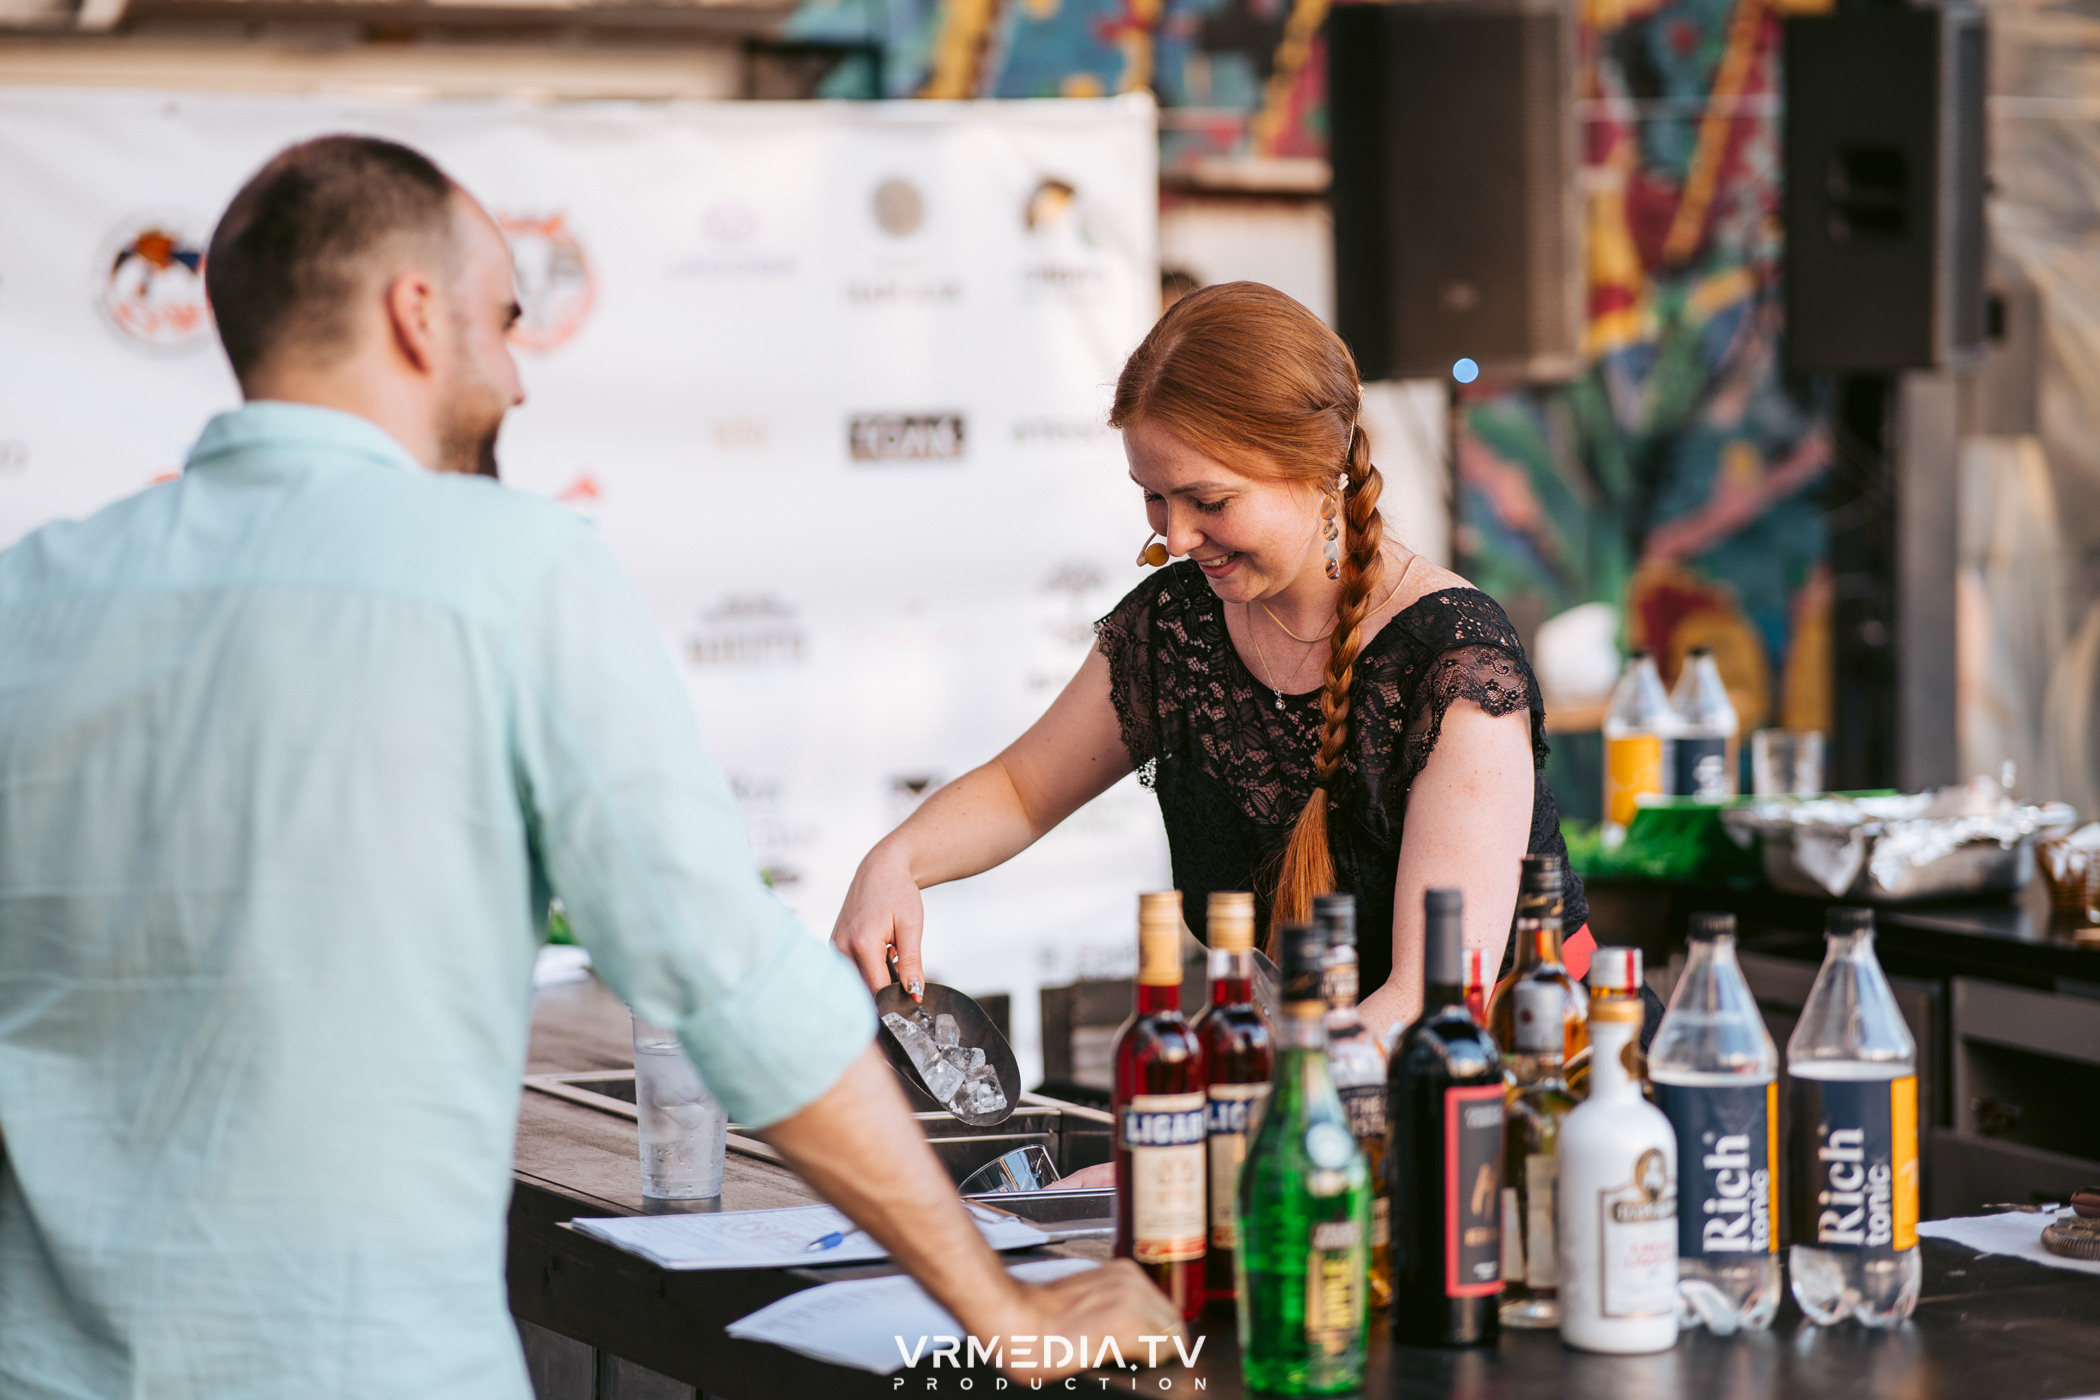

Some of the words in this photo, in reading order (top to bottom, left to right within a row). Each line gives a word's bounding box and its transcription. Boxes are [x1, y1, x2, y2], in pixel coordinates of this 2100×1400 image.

[1702, 1133, 1750, 1252] Rich
[1818, 1128, 1865, 1245] Rich
[1863, 1162, 1892, 1248] tonic
